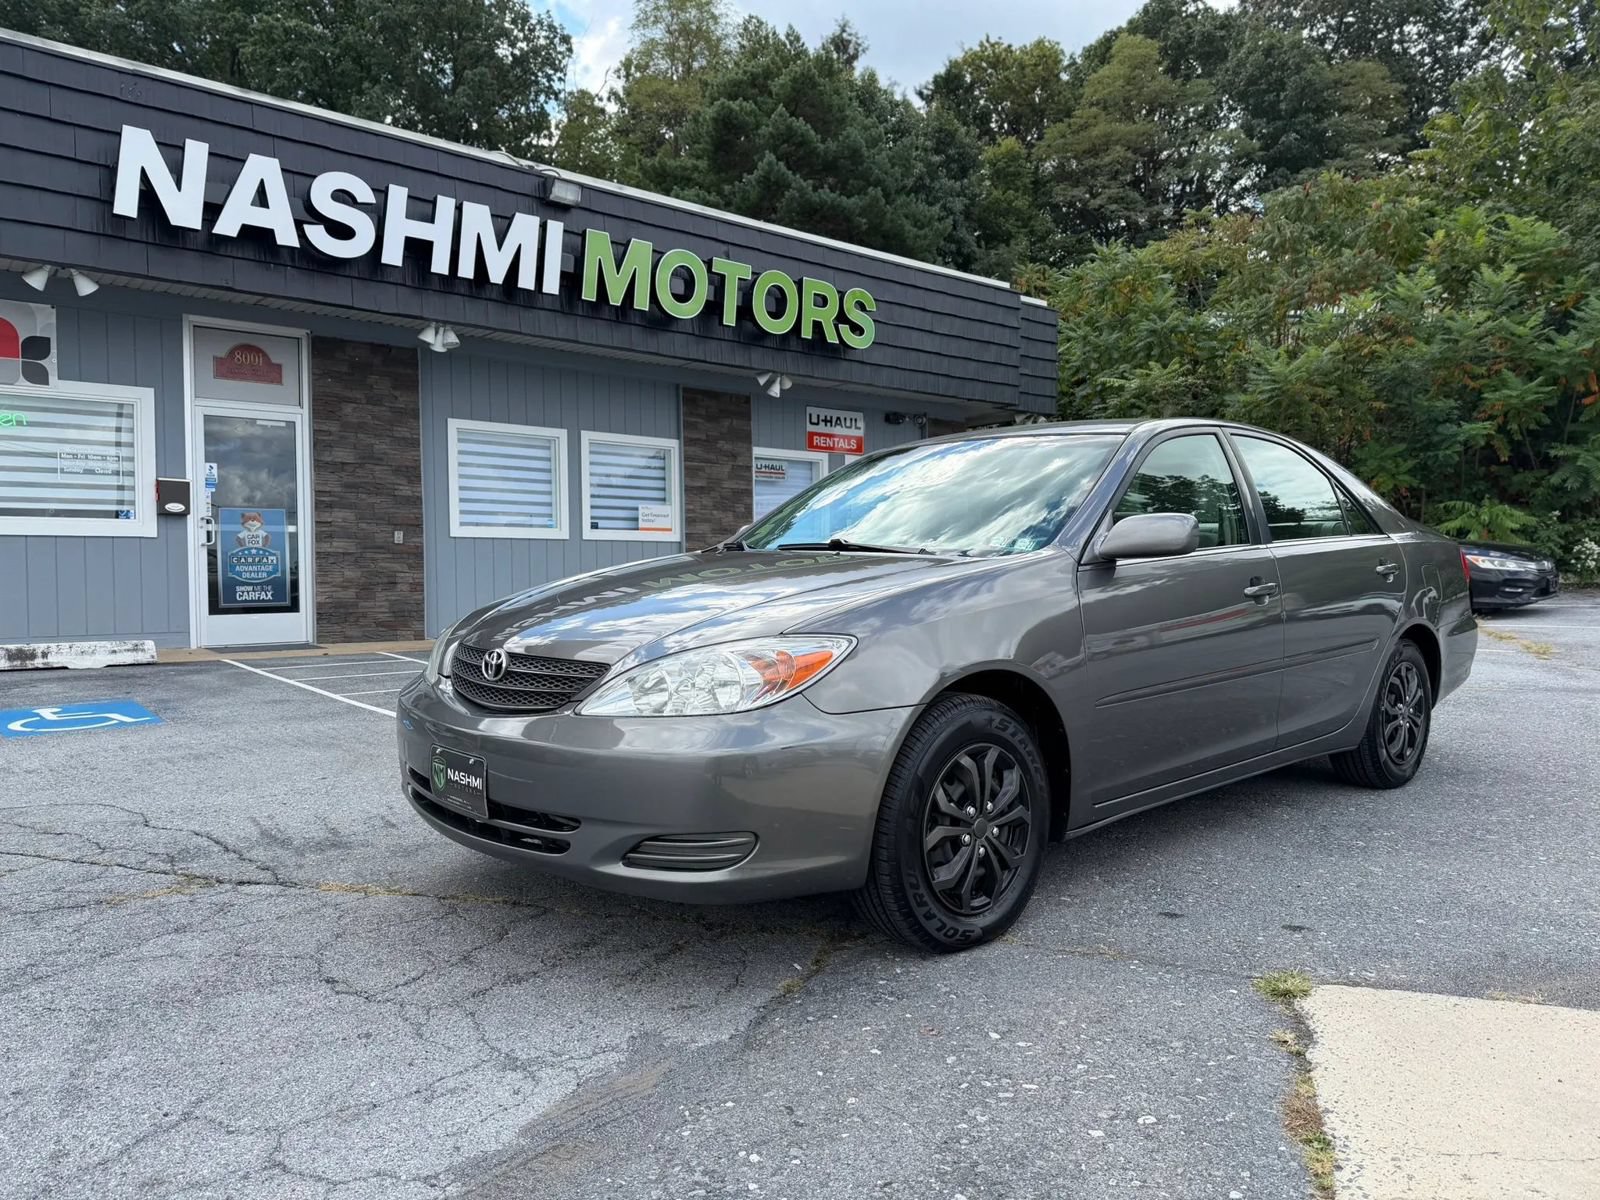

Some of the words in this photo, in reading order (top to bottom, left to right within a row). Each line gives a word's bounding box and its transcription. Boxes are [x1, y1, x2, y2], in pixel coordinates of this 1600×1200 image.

[113, 124, 564, 295] NASHMI
[581, 228, 877, 349] MOTORS
[234, 350, 262, 366] 8001
[808, 413, 862, 430] U-HAUL
[813, 435, 857, 449] RENTALS
[755, 463, 785, 471] U-HAUL
[236, 591, 273, 600] CARFAX
[447, 767, 483, 790] NASHMI
